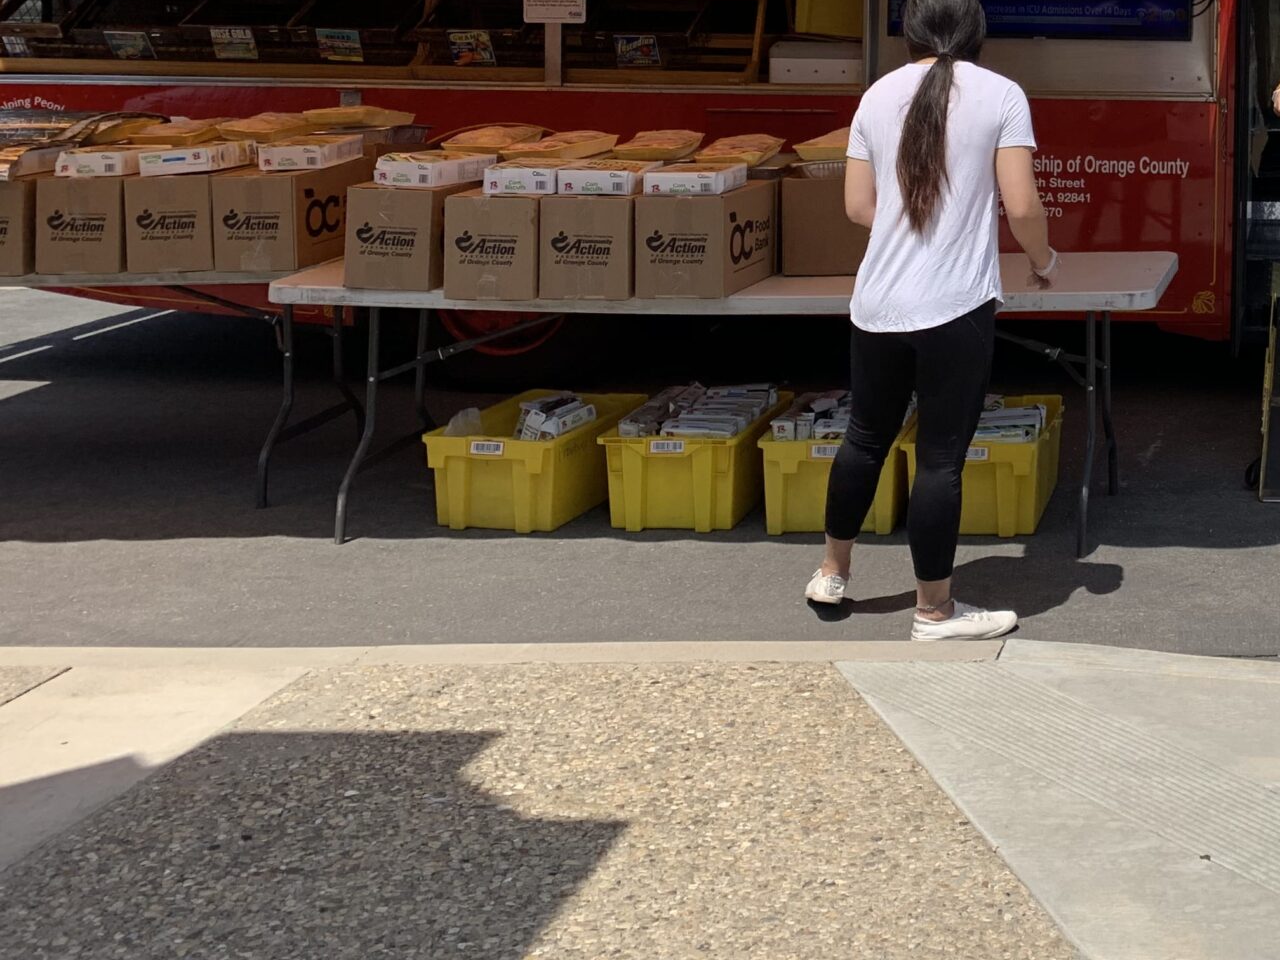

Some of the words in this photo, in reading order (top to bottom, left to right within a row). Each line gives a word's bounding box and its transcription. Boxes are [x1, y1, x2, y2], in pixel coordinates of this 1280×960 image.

[1067, 155, 1081, 173] of
[1084, 155, 1136, 178] Orange
[1139, 155, 1190, 179] County
[1049, 178, 1085, 188] Street
[1038, 193, 1054, 203] CA
[1057, 193, 1091, 203] 92841
[65, 215, 105, 232] Action
[152, 214, 196, 231] Action
[237, 214, 280, 231] Action
[304, 194, 340, 238] OC
[755, 215, 770, 234] Food
[370, 230, 416, 247] Action
[468, 238, 516, 255] Action
[565, 238, 611, 256] Action
[659, 236, 706, 253] Action
[729, 219, 754, 265] OC
